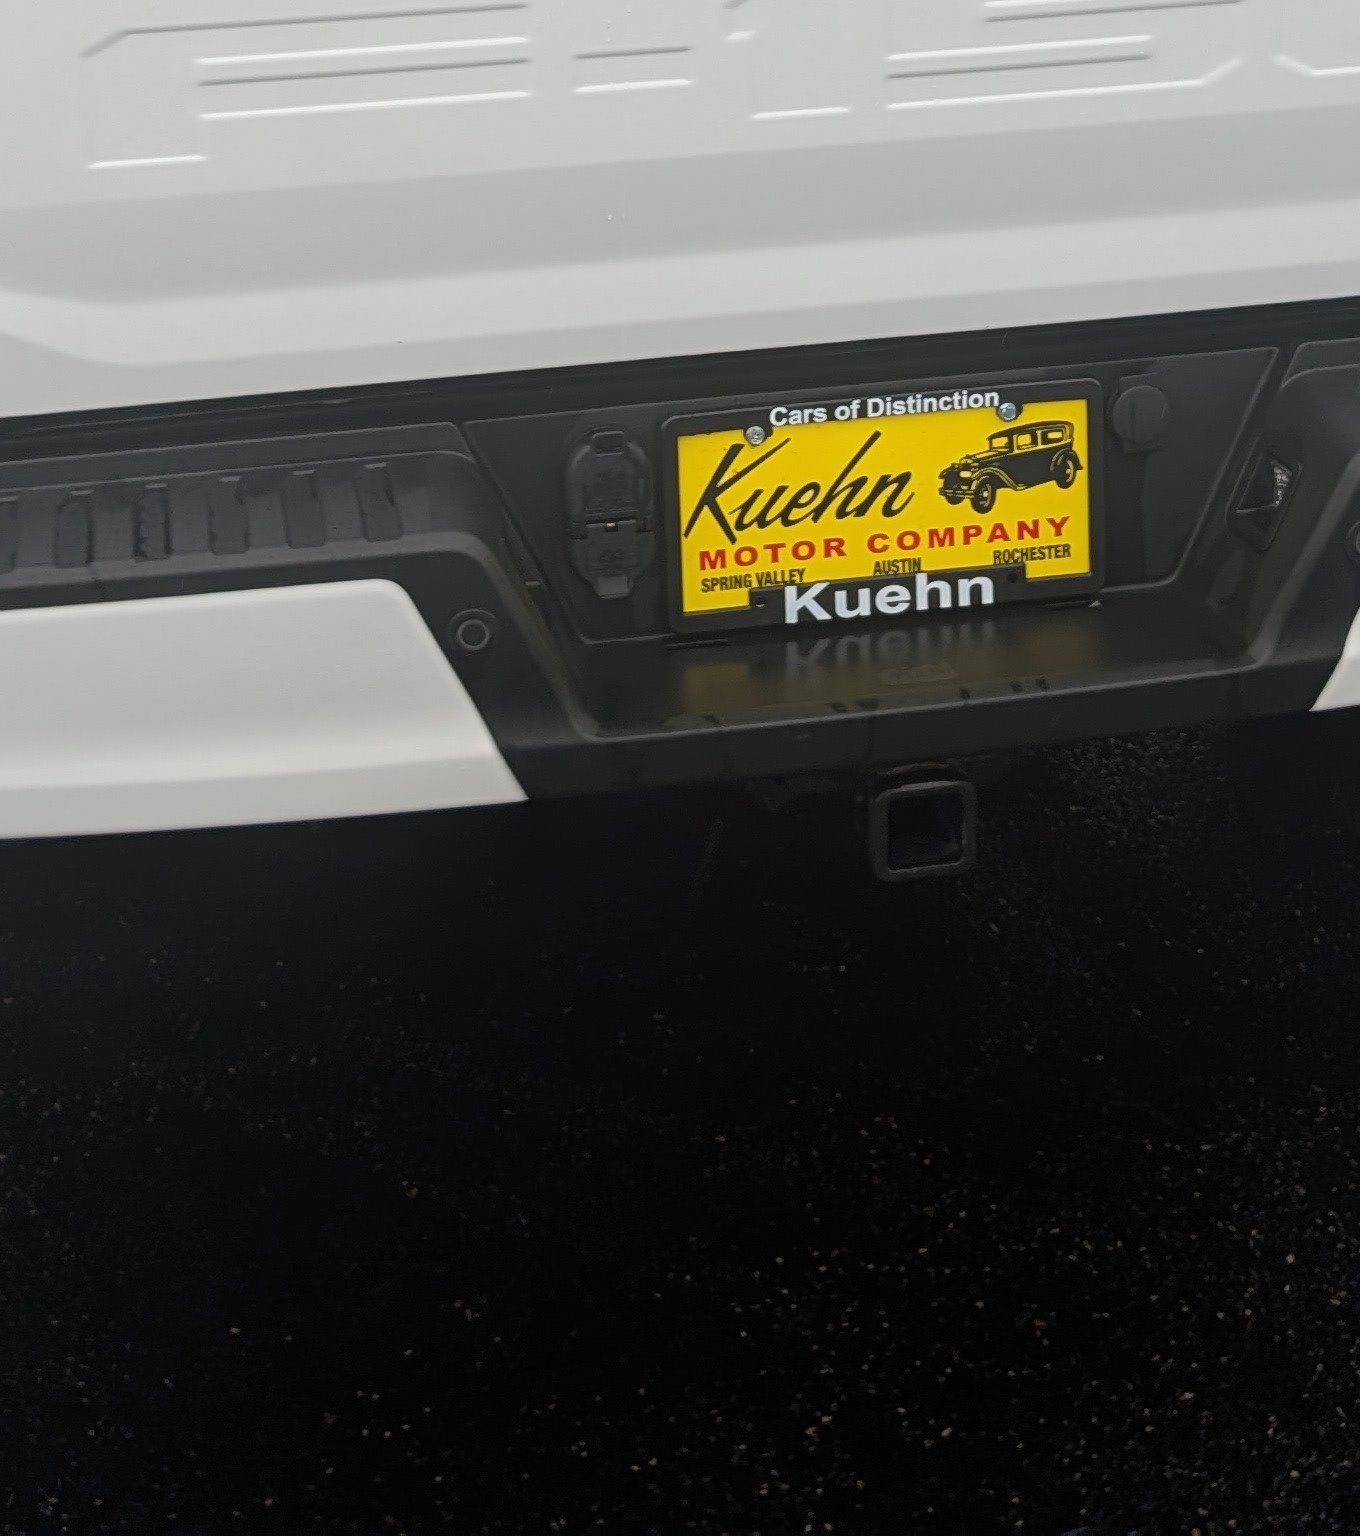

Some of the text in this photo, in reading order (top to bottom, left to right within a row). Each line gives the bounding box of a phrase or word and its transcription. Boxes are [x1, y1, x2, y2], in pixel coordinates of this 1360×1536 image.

[769, 390, 1000, 427] Cars of Distinction
[683, 430, 915, 545] Kuehn
[699, 515, 1072, 571] MOTOR COMPANY
[993, 543, 1072, 565] ROCHESTER
[700, 567, 806, 593] SPRING VALLEY
[873, 557, 922, 576] AUSTIN
[784, 572, 995, 624] Kuehn
